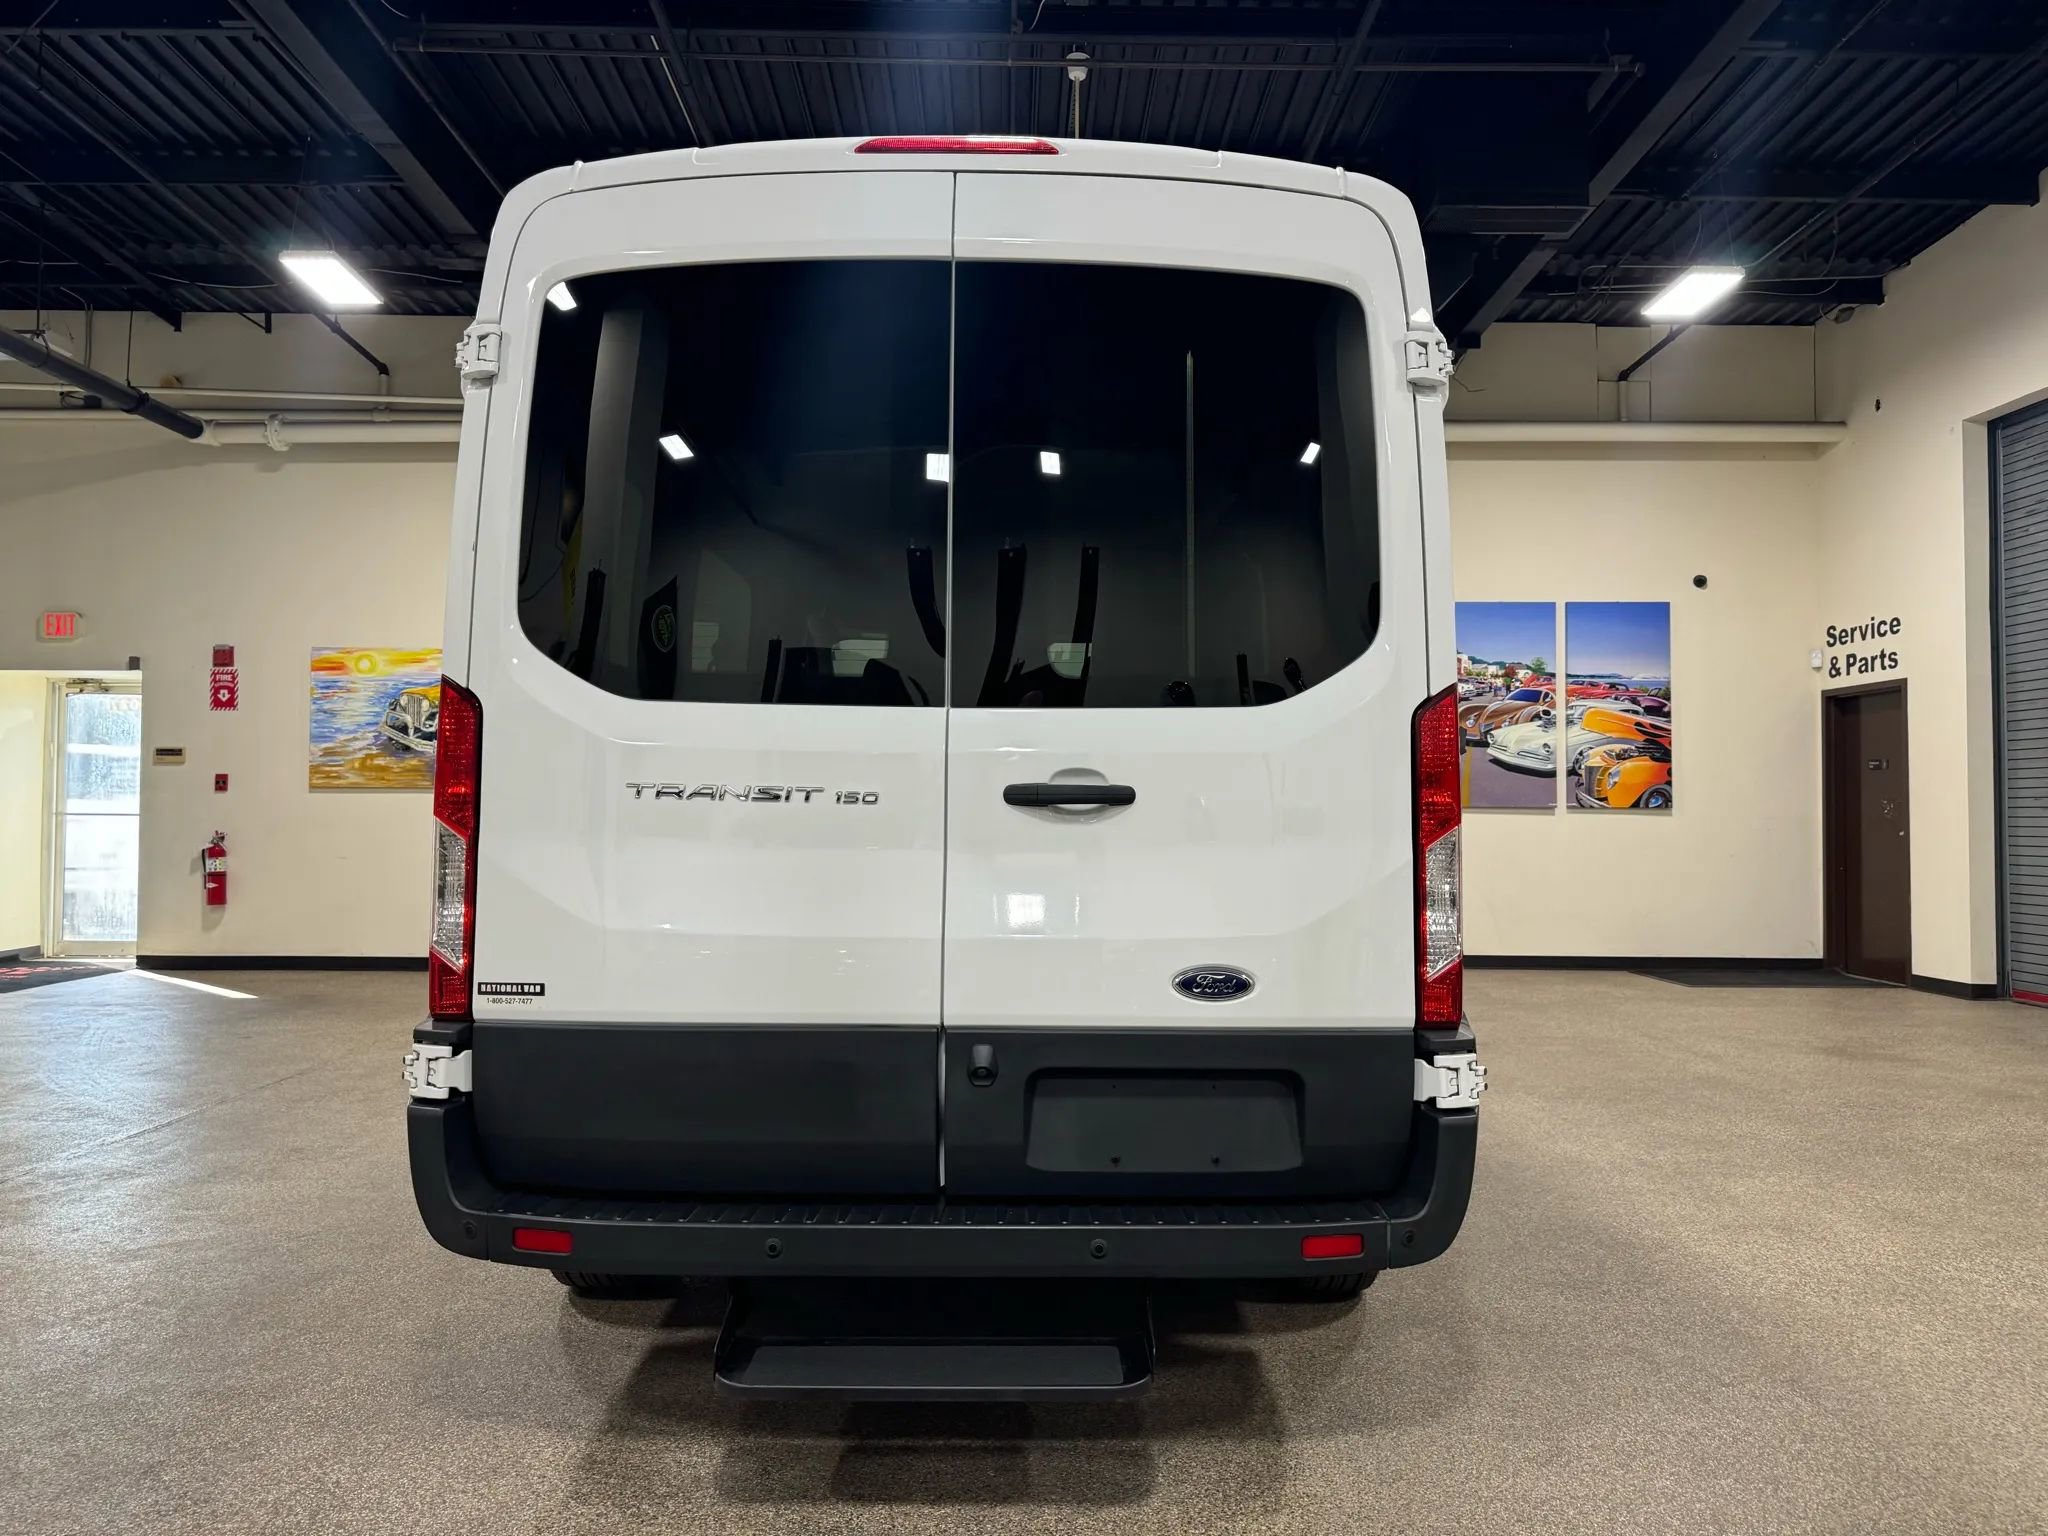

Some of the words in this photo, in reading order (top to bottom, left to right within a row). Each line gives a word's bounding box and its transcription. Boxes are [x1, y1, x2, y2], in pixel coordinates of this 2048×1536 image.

[46, 613, 75, 637] EXIT
[1826, 616, 1901, 648] Service
[1828, 655, 1842, 679] &
[1845, 648, 1898, 676] Parts
[626, 782, 825, 804] TRANSIT
[834, 790, 880, 805] 150
[480, 983, 522, 993] NATIONAL
[523, 984, 541, 993] VAN
[1192, 974, 1237, 993] Ford
[486, 997, 533, 1005] 1-800-527-7477
